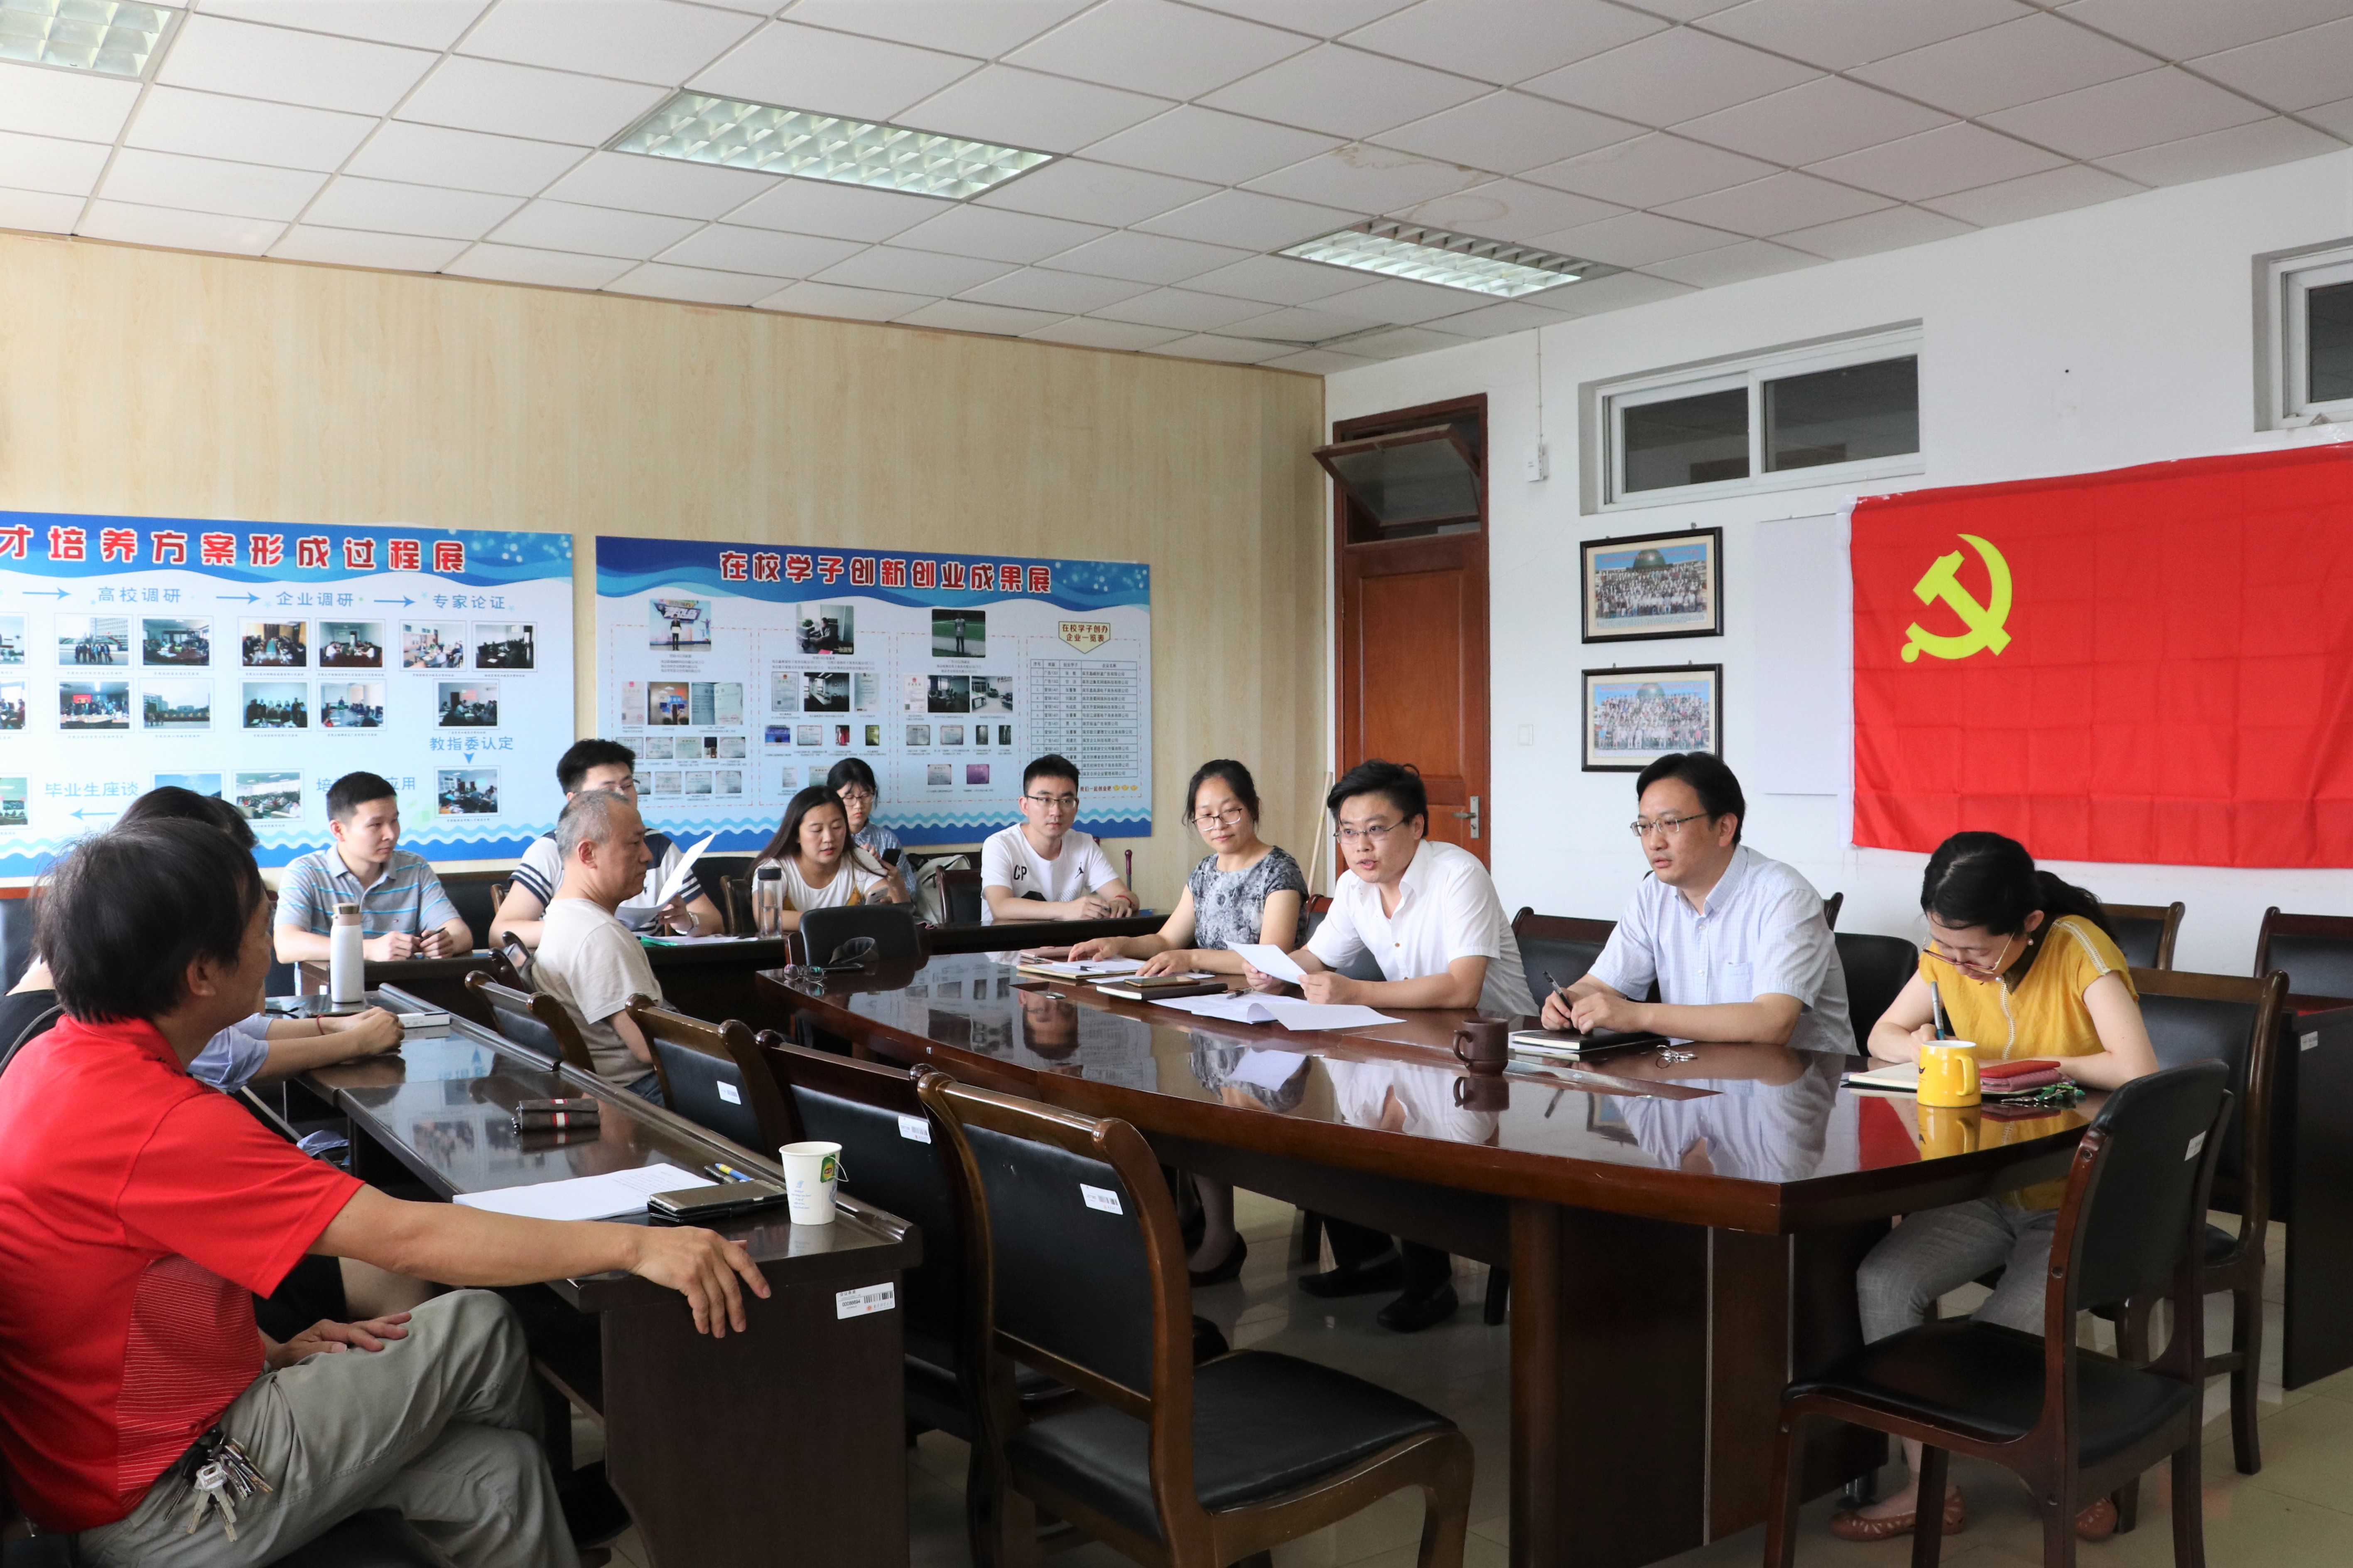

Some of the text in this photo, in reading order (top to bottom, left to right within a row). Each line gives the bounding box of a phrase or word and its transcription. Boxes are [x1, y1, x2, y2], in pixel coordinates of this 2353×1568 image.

[0, 524, 465, 573] 才培养方案形成过程展
[719, 550, 1051, 594] 在校学子创新创业成果展
[98, 586, 182, 604] 高校调研
[276, 590, 354, 608] 企业调研
[432, 594, 505, 610] 专家论证
[1062, 624, 1108, 633] 在校学子创办
[1066, 633, 1104, 642] 企业一览表
[429, 735, 514, 752] 教指委认定
[45, 781, 139, 798] 毕业生座谈
[316, 776, 416, 792] 培应用
[1013, 865, 1028, 881] CP
